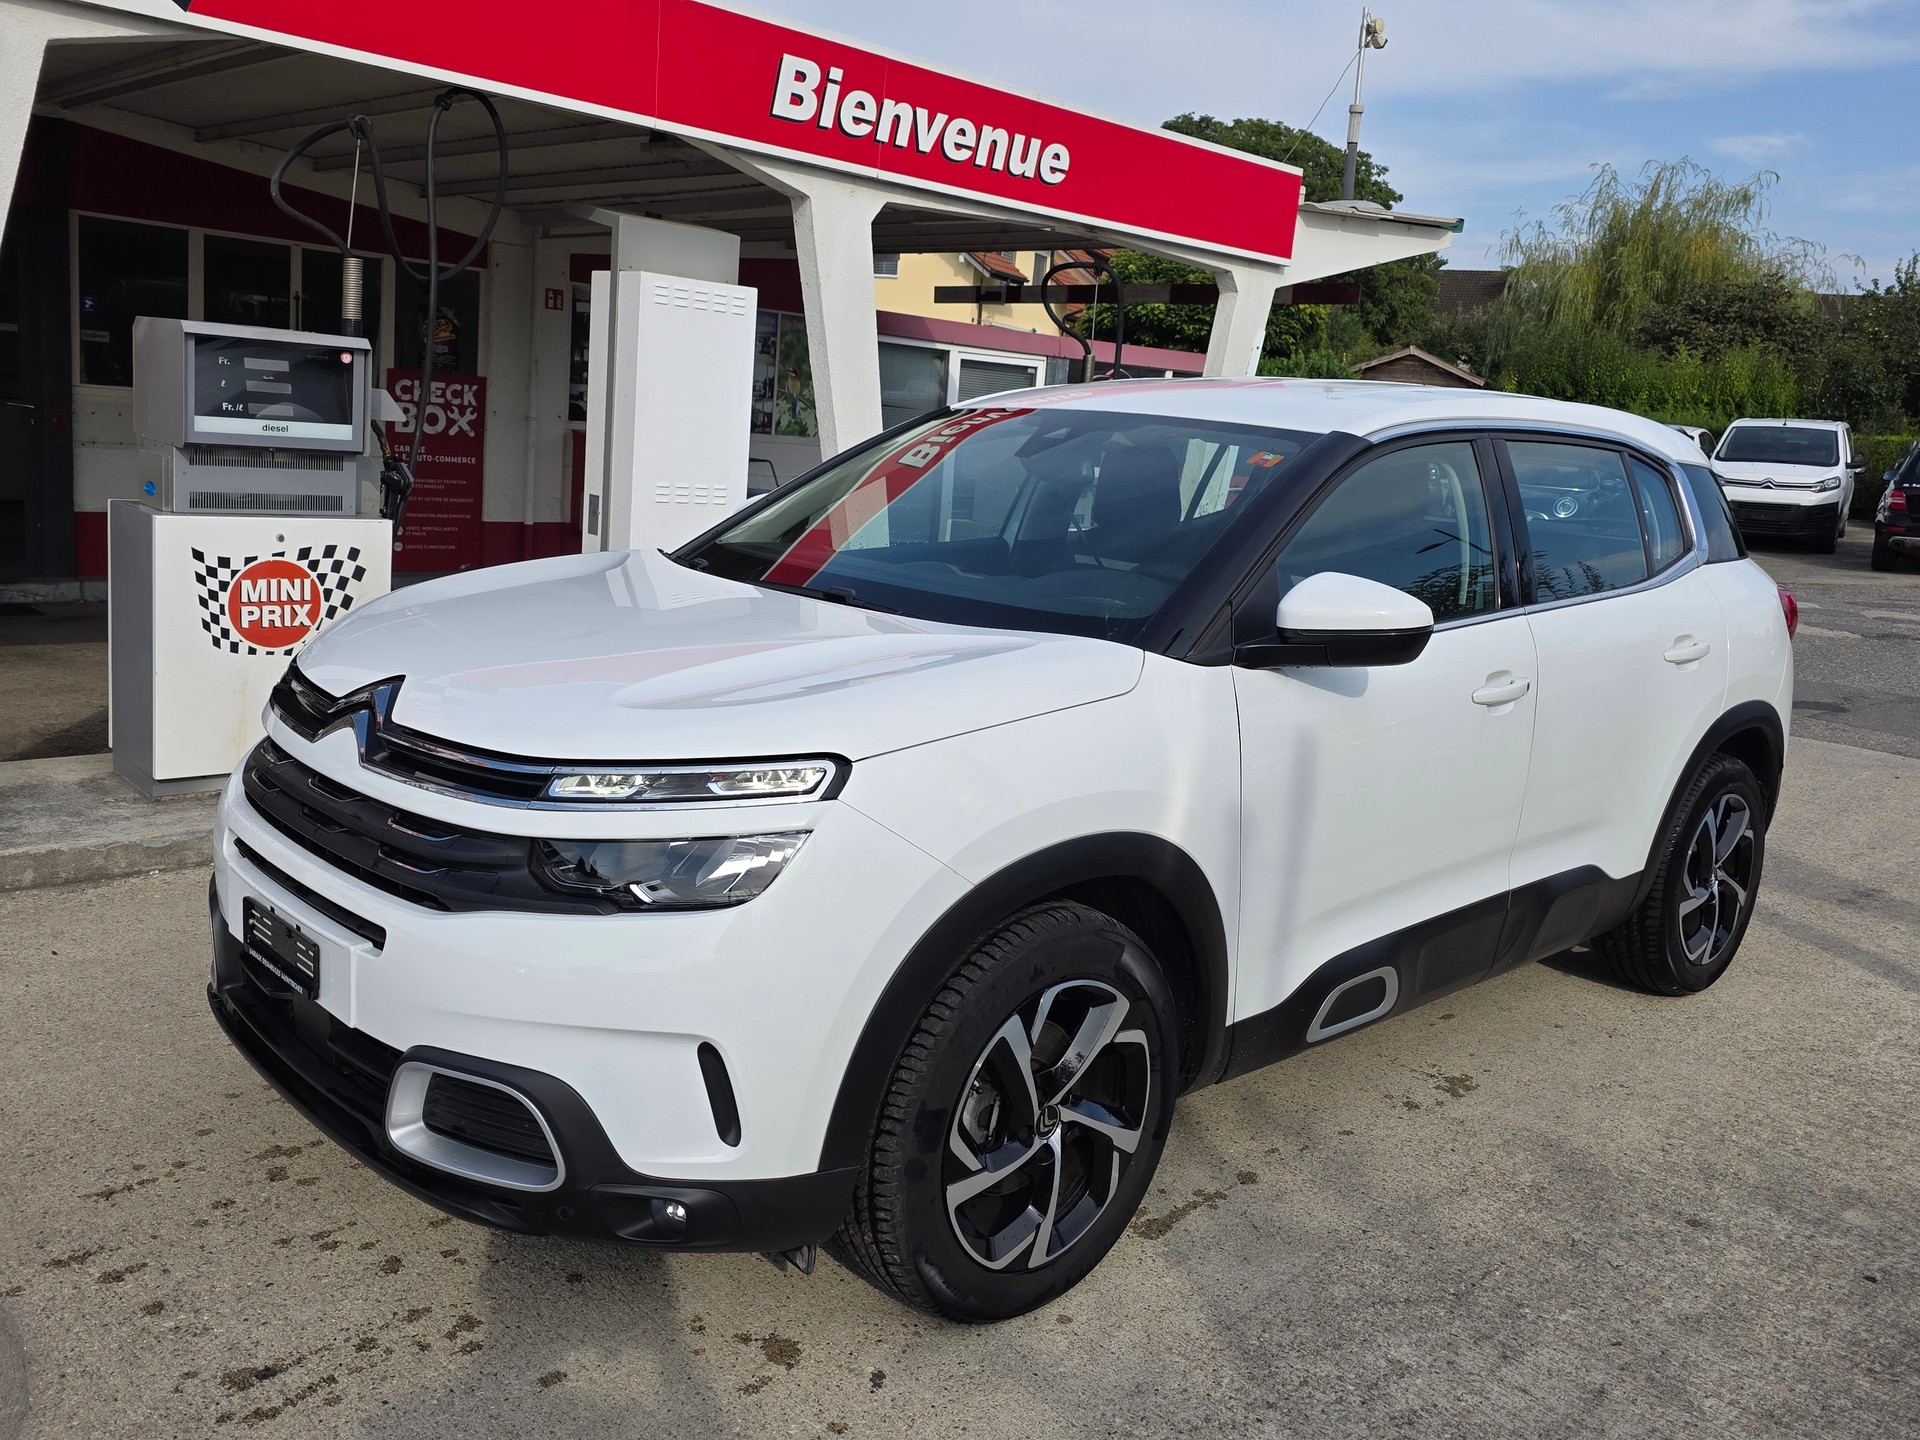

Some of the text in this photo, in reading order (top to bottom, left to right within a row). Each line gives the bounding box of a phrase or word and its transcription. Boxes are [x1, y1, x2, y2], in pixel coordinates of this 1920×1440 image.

[769, 53, 1070, 185] Bienvenue
[218, 356, 231, 366] Fr.
[262, 424, 289, 433] diesel
[394, 401, 478, 438] BOX
[394, 444, 426, 454] GARE
[416, 454, 476, 465] UTO-COMMERCE
[240, 578, 312, 603] MINI
[240, 604, 313, 629] PRIX
